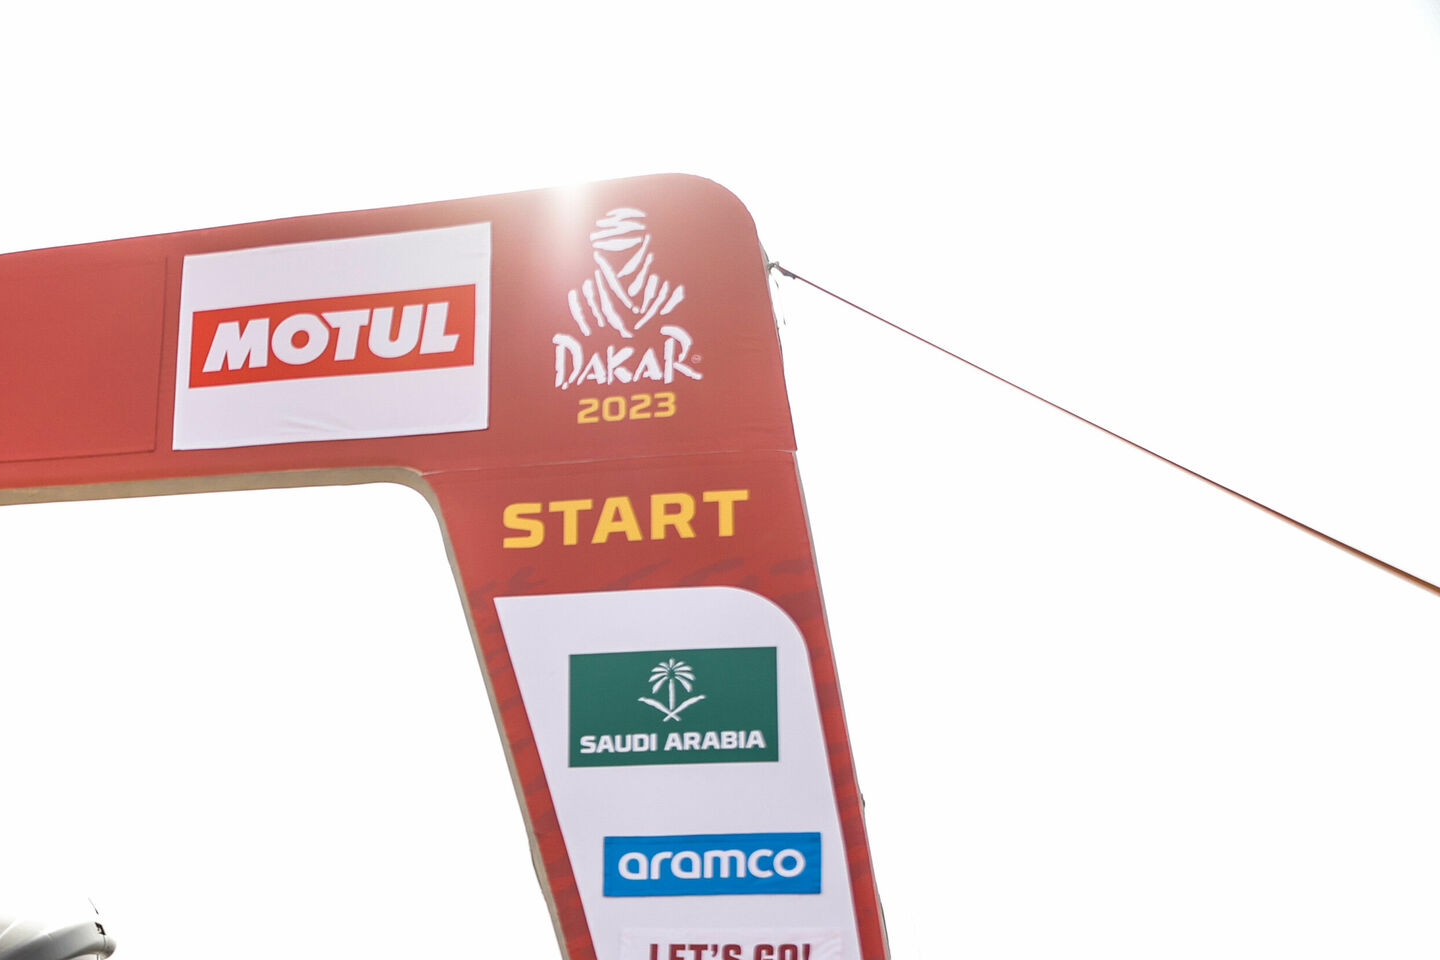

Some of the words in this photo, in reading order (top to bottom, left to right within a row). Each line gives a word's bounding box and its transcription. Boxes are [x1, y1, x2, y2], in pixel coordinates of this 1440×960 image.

[201, 302, 460, 373] MOTUL
[552, 325, 702, 390] DAKAR
[577, 391, 677, 425] 2023
[503, 489, 750, 549] START
[580, 733, 658, 754] SAUDI
[663, 729, 767, 752] ARABIA
[618, 848, 806, 880] aramco
